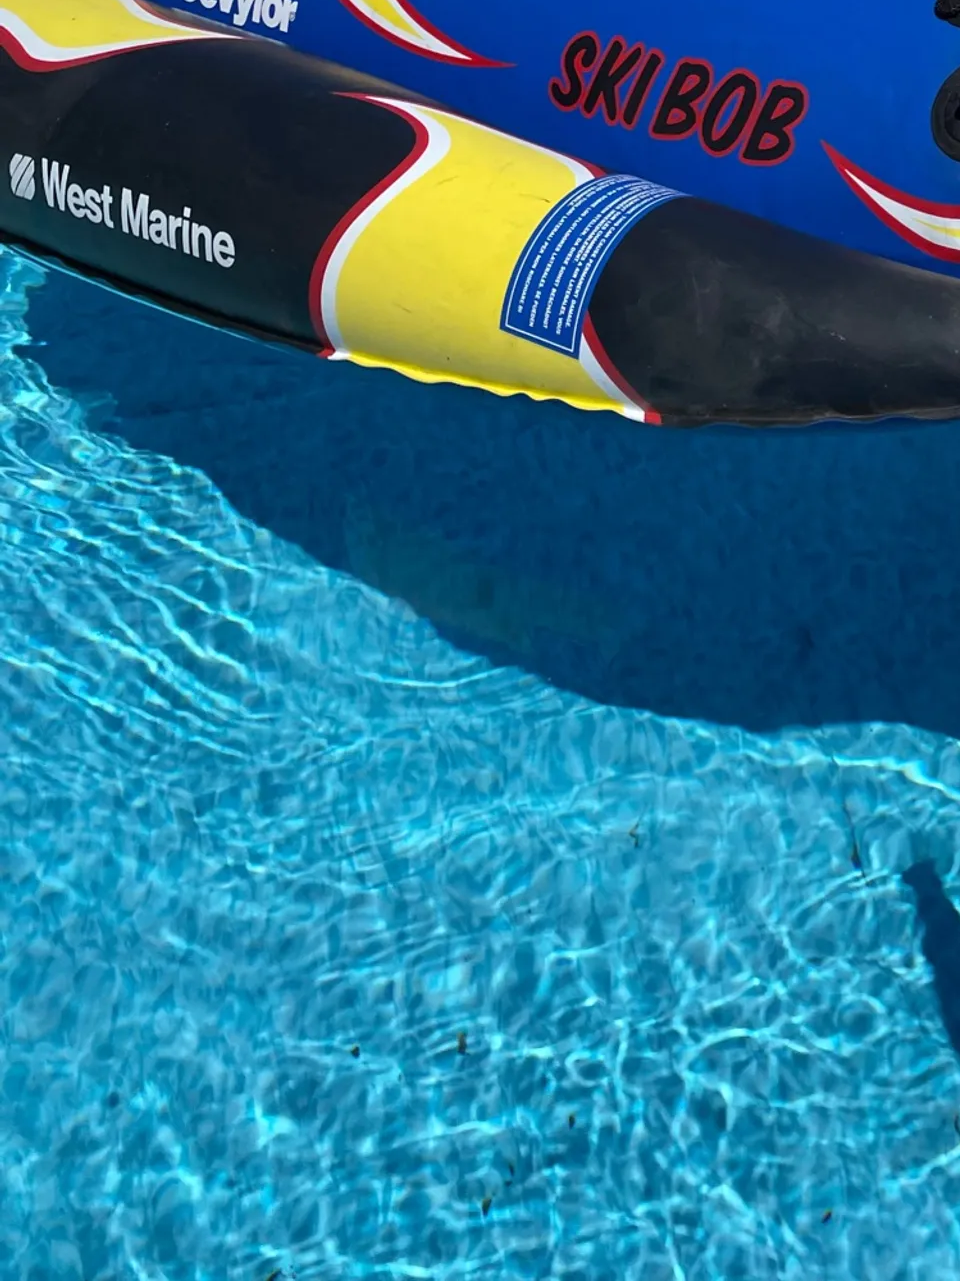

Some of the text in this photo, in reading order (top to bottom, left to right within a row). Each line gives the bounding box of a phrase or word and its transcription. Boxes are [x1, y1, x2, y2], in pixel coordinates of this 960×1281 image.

[549, 30, 809, 167] SKI BOB
[41, 157, 236, 268] West Marine
[604, 226, 616, 238] CAN
[590, 238, 607, 259] CAUSE
[573, 258, 594, 298] PERMANENT
